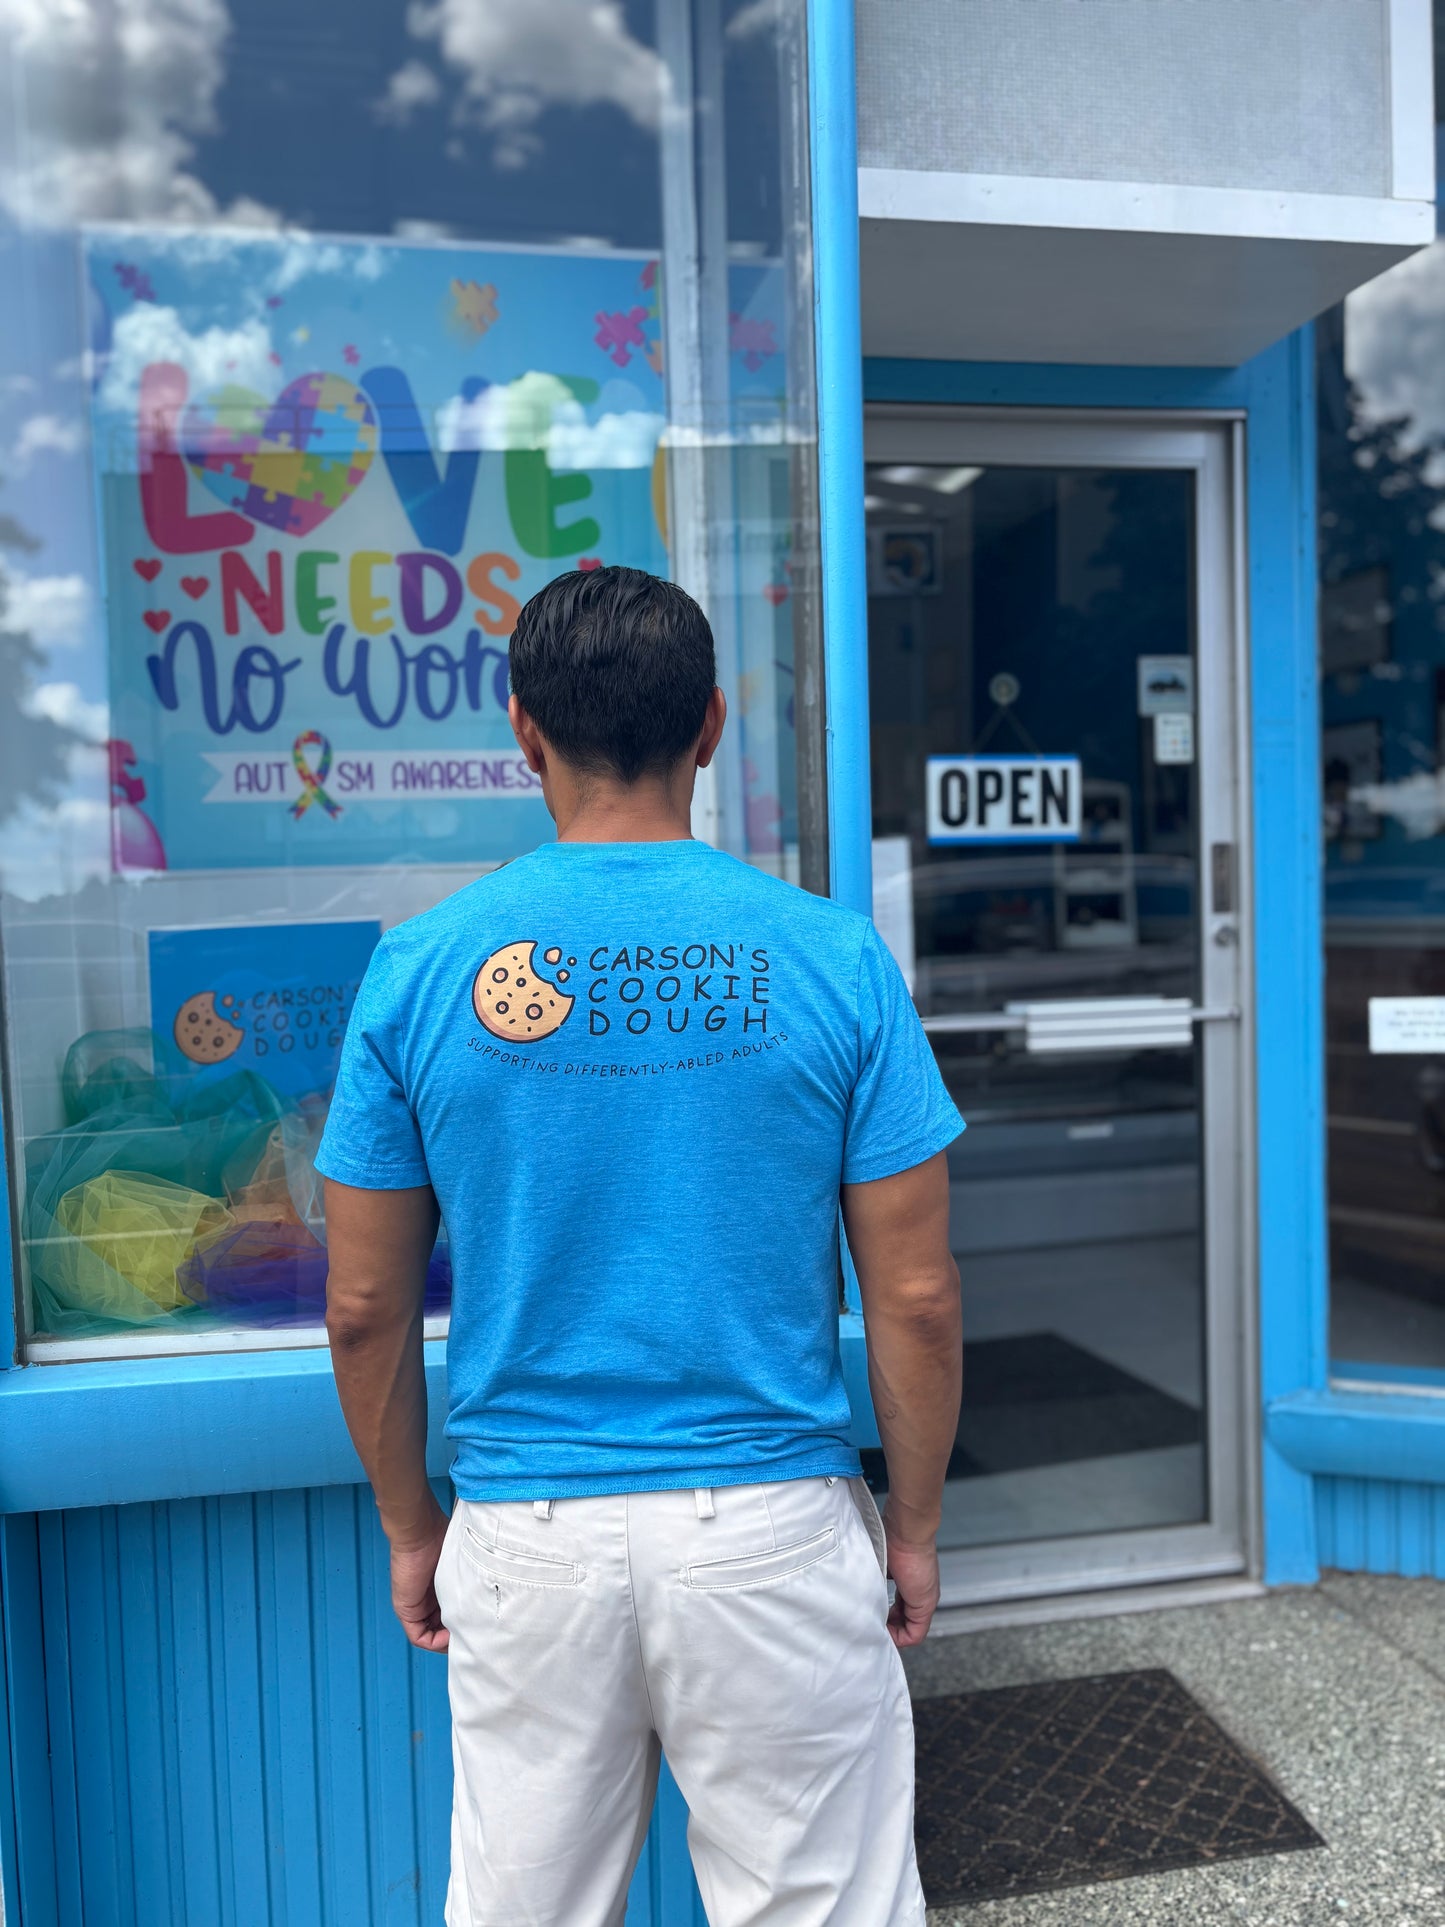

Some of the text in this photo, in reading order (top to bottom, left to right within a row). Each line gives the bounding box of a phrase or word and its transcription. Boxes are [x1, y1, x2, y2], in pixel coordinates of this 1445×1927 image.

[220, 550, 521, 636] NEEDS
[939, 767, 1070, 828] OPEN
[588, 943, 770, 972] CARSON'S
[588, 974, 770, 1004] COOKIE
[252, 1006, 348, 1033] COOKI
[589, 1005, 767, 1036] DOUGH
[254, 1029, 342, 1057] DOUG
[467, 1031, 789, 1077] SUPPORTING DIFFERENTLY-ABLED ADULTS
